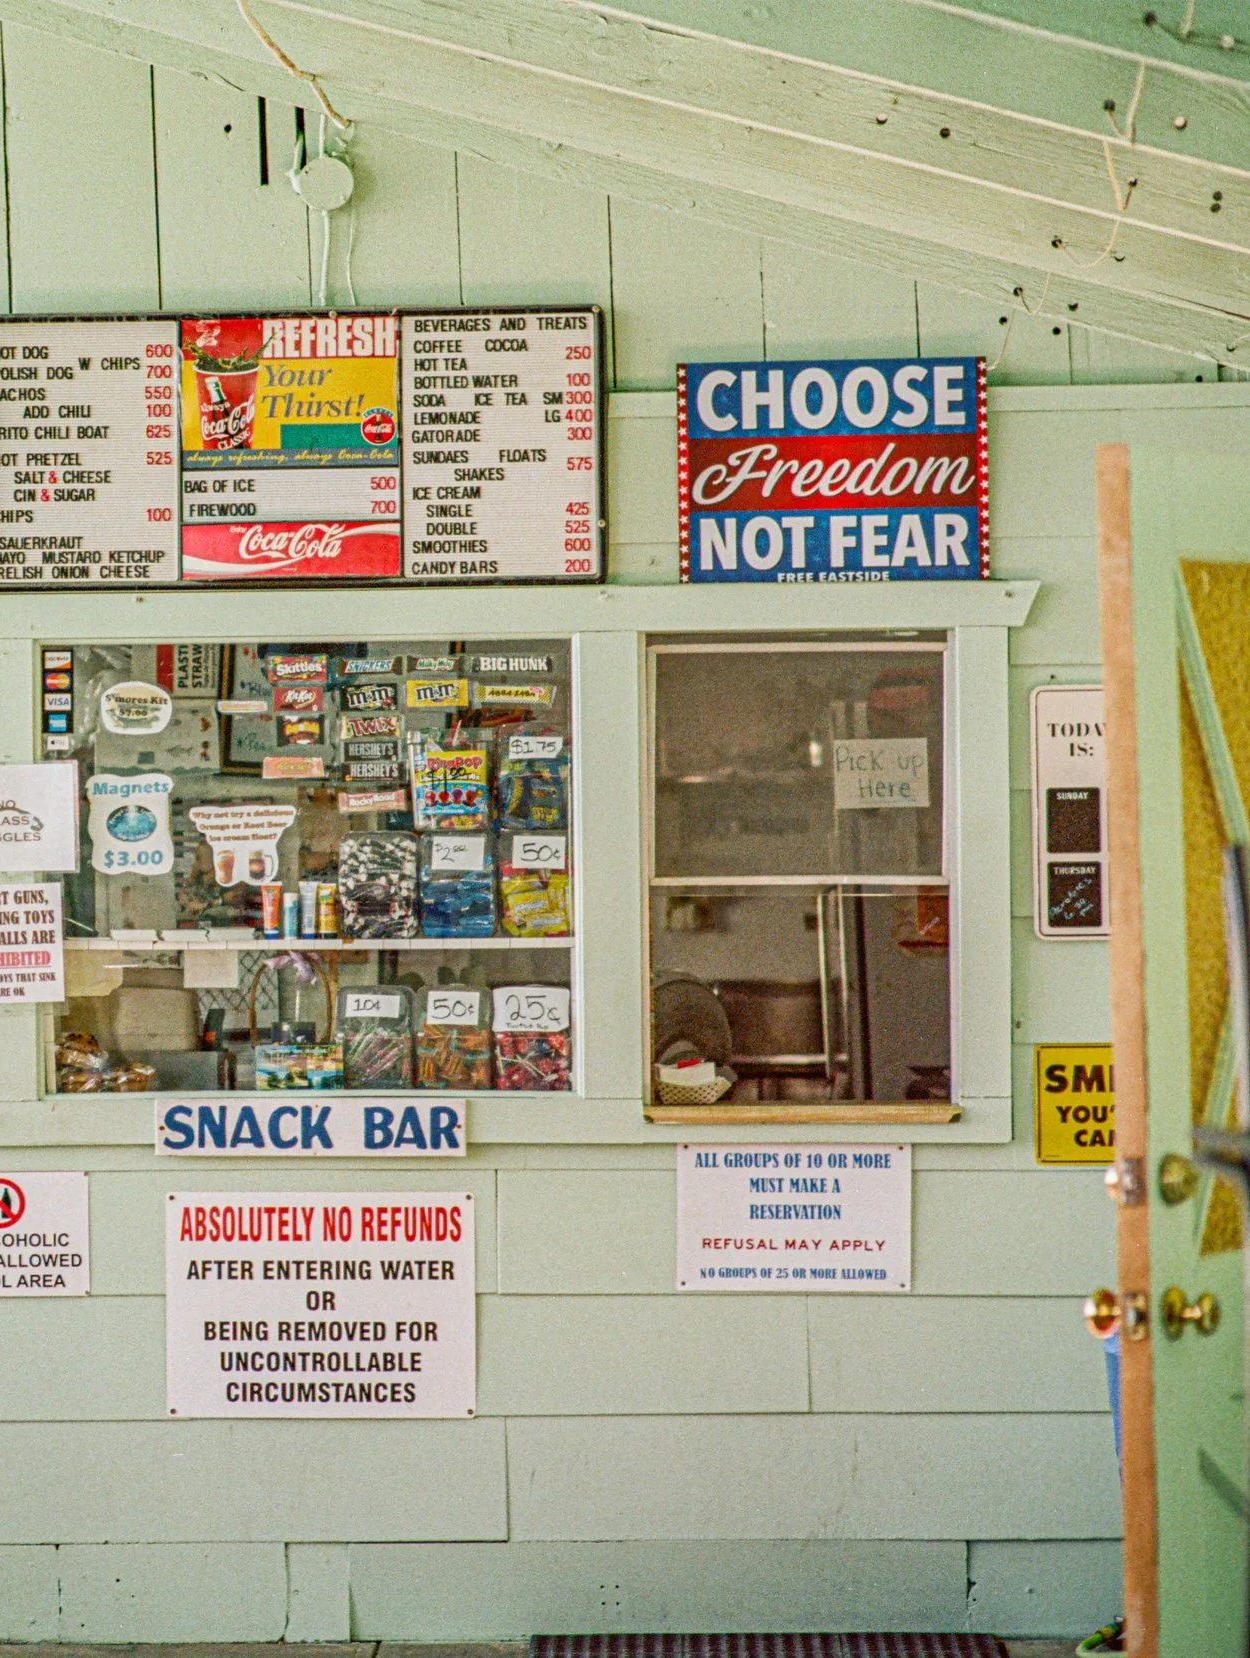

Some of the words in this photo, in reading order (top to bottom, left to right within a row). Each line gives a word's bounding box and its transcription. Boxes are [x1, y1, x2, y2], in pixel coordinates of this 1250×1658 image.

[414, 319, 490, 332] BEVERAGES
[500, 318, 525, 331] AND
[537, 317, 586, 330] TREATS
[262, 318, 395, 358] REFRESH
[23, 347, 48, 359] DOG
[146, 345, 172, 357] 600
[414, 340, 462, 353] COFFEE
[485, 339, 528, 351] COCOA
[566, 347, 591, 360] 250
[46, 367, 73, 379] DOG
[146, 366, 172, 378] 700
[264, 365, 332, 387] Your
[414, 376, 468, 389] BOTTLED
[472, 375, 518, 388] WATER
[566, 374, 590, 386] 100
[145, 387, 172, 399] 550
[414, 395, 445, 407] SODA
[475, 394, 493, 406] ICE
[505, 393, 527, 405] TEA
[543, 393, 563, 404] SM
[566, 392, 592, 404] 300
[697, 365, 966, 432] CHOOSE
[262, 394, 364, 418] Thirst!
[35, 427, 70, 439] CHILI
[77, 426, 109, 438] BOAT
[146, 425, 171, 437] 625
[27, 453, 82, 466] PRETZEL
[146, 452, 172, 464] 525
[187, 452, 224, 467] always
[295, 451, 333, 465] always
[413, 451, 468, 463] SUNDAES
[500, 450, 546, 462] FLOATS
[567, 457, 592, 470] 575
[692, 443, 976, 505] Freedom
[184, 480, 207, 493] BAG
[213, 480, 227, 493] OF
[233, 479, 255, 492] ICE
[371, 477, 396, 489] 500
[413, 488, 432, 499] ICE
[437, 487, 481, 499] CREAM
[239, 524, 346, 559] Coca-Cola
[413, 541, 487, 554] SMOOTHIES
[564, 539, 591, 551] 600
[699, 516, 814, 570] NOT
[830, 514, 970, 568] FEAR
[412, 562, 455, 574] CANDY
[460, 561, 498, 573] BARS
[565, 560, 591, 572] 200
[778, 572, 814, 583] FREE
[819, 571, 890, 582] EASTSIDE
[277, 662, 322, 675] Skittles
[480, 657, 507, 670] BIG
[509, 657, 548, 670] HUNK
[48, 698, 69, 706] VISA
[1070, 743, 1094, 756] IS:
[836, 745, 884, 771] Pick
[897, 755, 923, 777] up
[351, 763, 398, 776] HERSHEY'S
[92, 782, 169, 797] Magnets
[859, 778, 910, 798] Here
[1056, 792, 1088, 800] SUNDAY
[104, 851, 163, 867] $3.00
[1054, 866, 1096, 875] THURSDAY
[14, 890, 48, 906] GUNS,
[24, 910, 54, 924] TOYS
[163, 1105, 334, 1149] SNACK
[364, 1106, 460, 1149] BAR
[695, 1153, 719, 1168] ALL
[724, 1153, 779, 1169] GROUPS
[784, 1154, 801, 1168] OF
[807, 1154, 822, 1168] 10
[828, 1154, 847, 1168] OR
[852, 1154, 891, 1169] MORE
[750, 1205, 841, 1220] RESERVATION
[180, 1207, 314, 1242] ABSOLUTELY
[323, 1207, 352, 1242] NO
[361, 1207, 462, 1242] REFUNDS
[703, 1238, 777, 1250] REFUSAL
[785, 1240, 822, 1249] MAY
[830, 1240, 886, 1251] APPLY
[187, 1261, 254, 1280] AFTER
[263, 1260, 371, 1280] ENTERING
[380, 1260, 454, 1280] WATER
[17, 1275, 66, 1287] AREA
[220, 1352, 422, 1372] UNCONTROLLABLE
[226, 1382, 416, 1403] CIRCUMSTANCES
